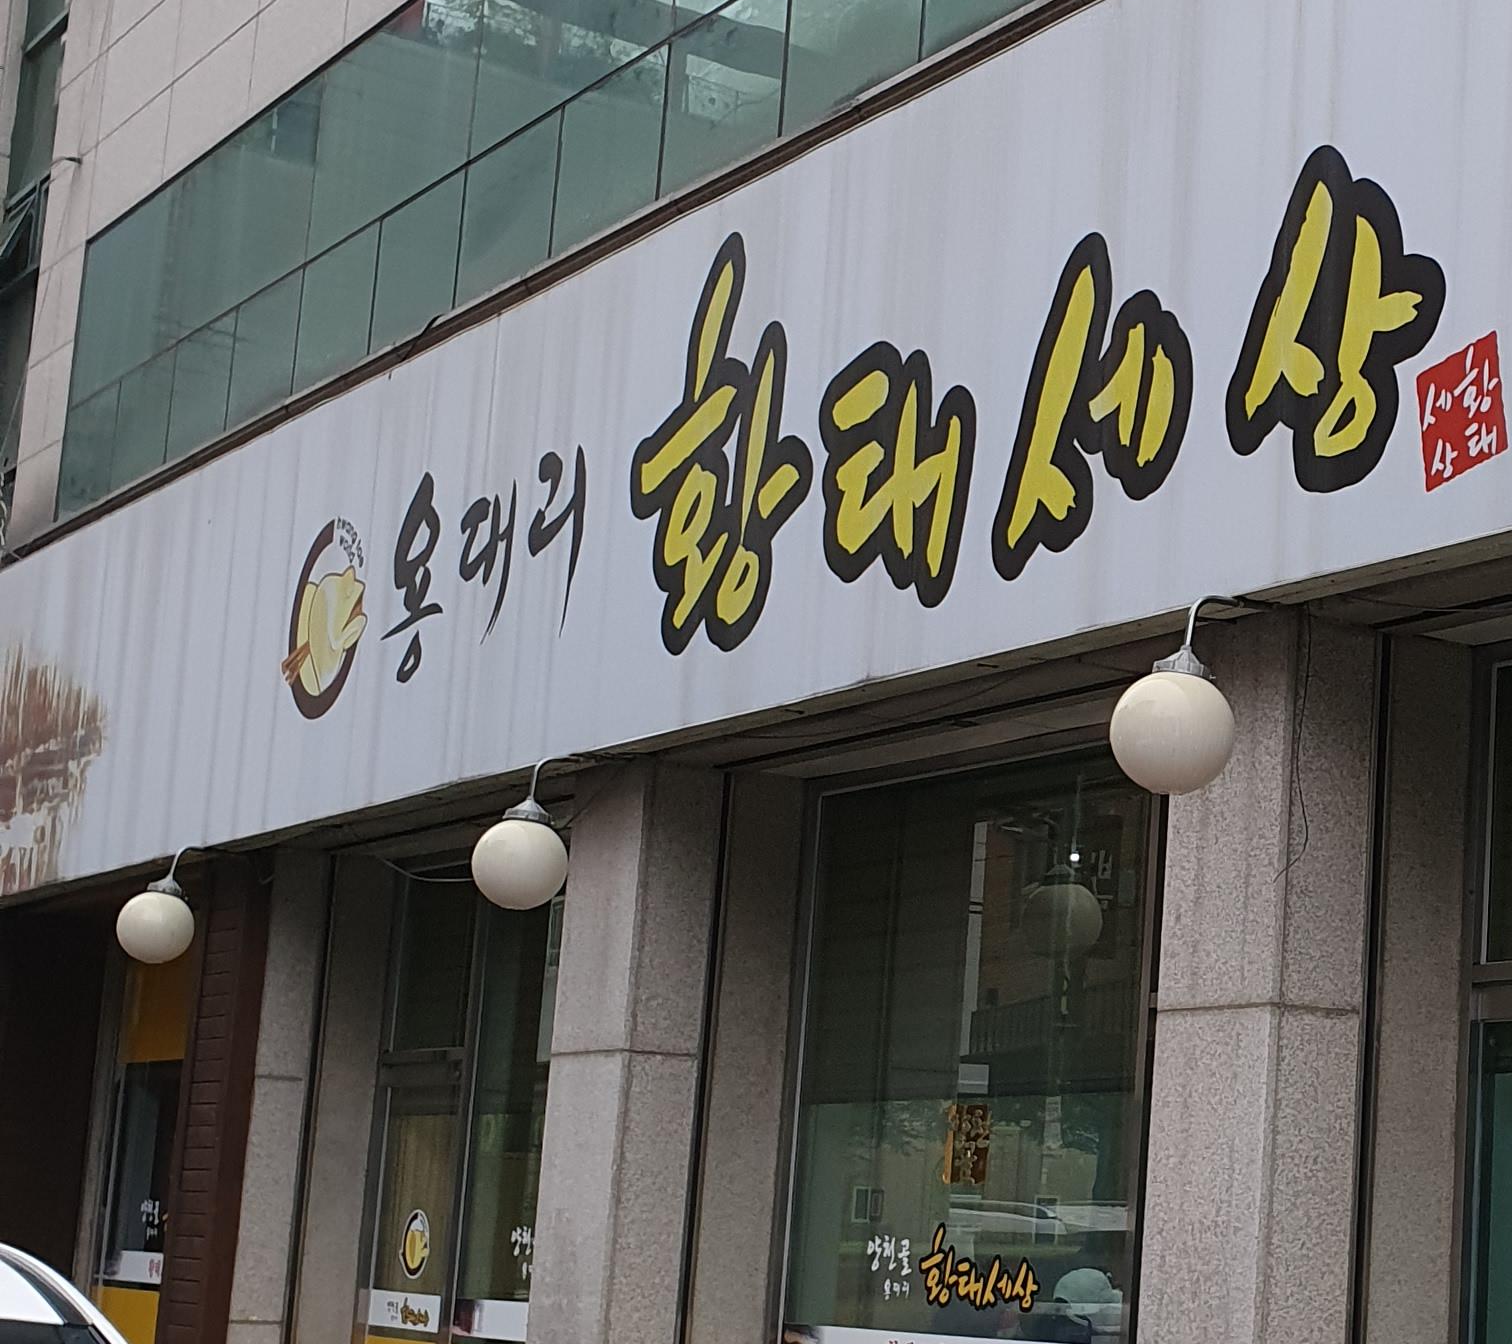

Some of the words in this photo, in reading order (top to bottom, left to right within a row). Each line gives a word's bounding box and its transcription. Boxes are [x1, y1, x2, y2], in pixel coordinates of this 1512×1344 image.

[381, 443, 586, 684] 용대리
[631, 144, 1447, 655] 황태세상
[918, 1221, 1041, 1313] 황태세상
